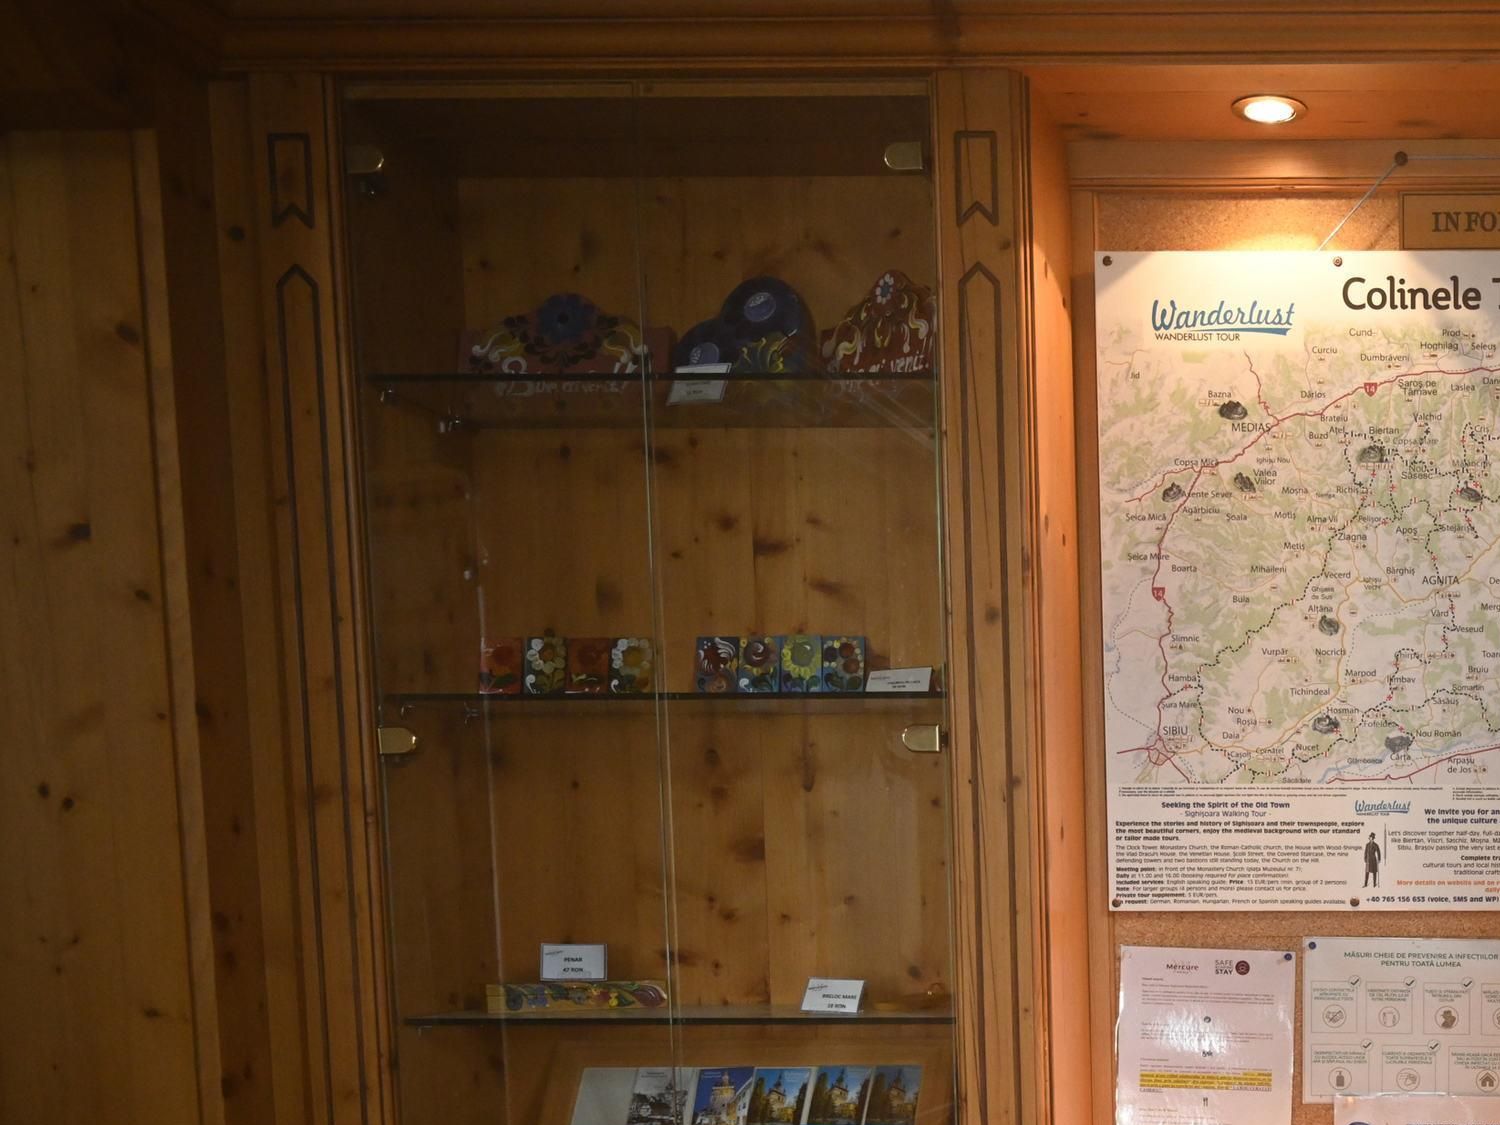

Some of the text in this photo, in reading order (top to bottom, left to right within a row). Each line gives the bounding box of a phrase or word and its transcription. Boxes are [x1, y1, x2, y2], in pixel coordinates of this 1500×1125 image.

[1342, 275, 1482, 311] Colinele
[1151, 300, 1295, 332] Wanderlust
[1155, 333, 1240, 341] WANDERLUST TOUR
[1349, 329, 1372, 337] Cund
[1442, 329, 1460, 337] Prod
[1312, 346, 1337, 354] Curciu
[1420, 342, 1458, 351] Hoghilag
[1450, 384, 1475, 392] Laslea
[1208, 390, 1231, 398] Bazna
[1320, 414, 1348, 422] Brateiu
[1253, 469, 1277, 477] Valea
[1254, 477, 1275, 485] Viilor
[1337, 533, 1367, 542] Zlagna
[1149, 553, 1170, 561] Mare
[1422, 576, 1460, 585] AGNITA
[1168, 674, 1197, 682] Hamba
[1345, 670, 1376, 678] Marpod
[1290, 687, 1330, 697] Țichindeal
[1163, 727, 1188, 736] SIBIU
[1222, 732, 1240, 740] Daia
[1458, 766, 1471, 774] Jos
[1161, 801, 1290, 809] Seeking the Spirit of the Old Town
[1355, 800, 1411, 813] Wanderlust
[1222, 810, 1249, 818] Walking
[1250, 810, 1267, 818] Tour
[1424, 808, 1436, 817] We
[1438, 808, 1460, 817] invite
[1461, 808, 1475, 817] you
[1477, 808, 1489, 817] for
[1491, 808, 1500, 817] an
[1382, 896, 1395, 904] 765
[1397, 896, 1410, 904] 156
[1453, 896, 1468, 904] SMS
[1469, 896, 1483, 904] and
[1166, 963, 1199, 971] Mercure
